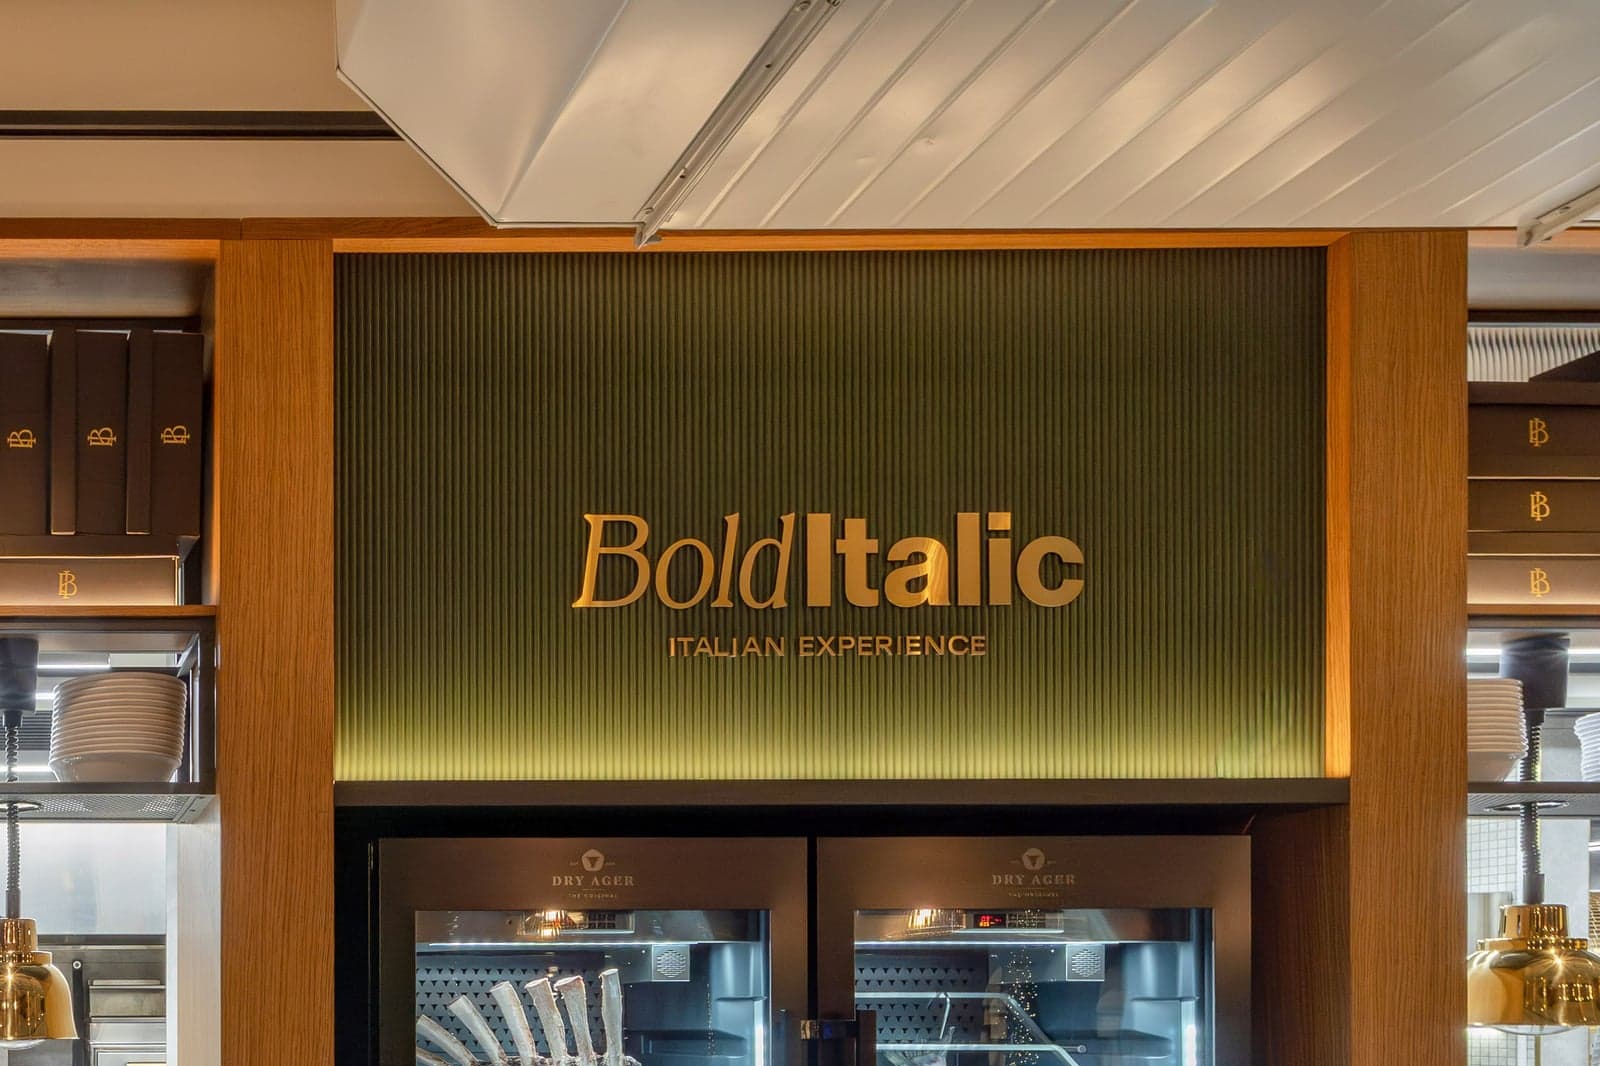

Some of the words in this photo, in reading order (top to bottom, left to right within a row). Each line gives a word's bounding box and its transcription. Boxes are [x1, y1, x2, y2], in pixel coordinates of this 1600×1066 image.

[572, 512, 1086, 609] BoldItalic
[669, 636, 786, 656] ITALIAN
[799, 636, 988, 656] EXPERIENCE
[552, 875, 585, 886] DRY
[591, 875, 634, 886] AGER
[992, 874, 1025, 885] DRY
[1031, 874, 1076, 885] AGER
